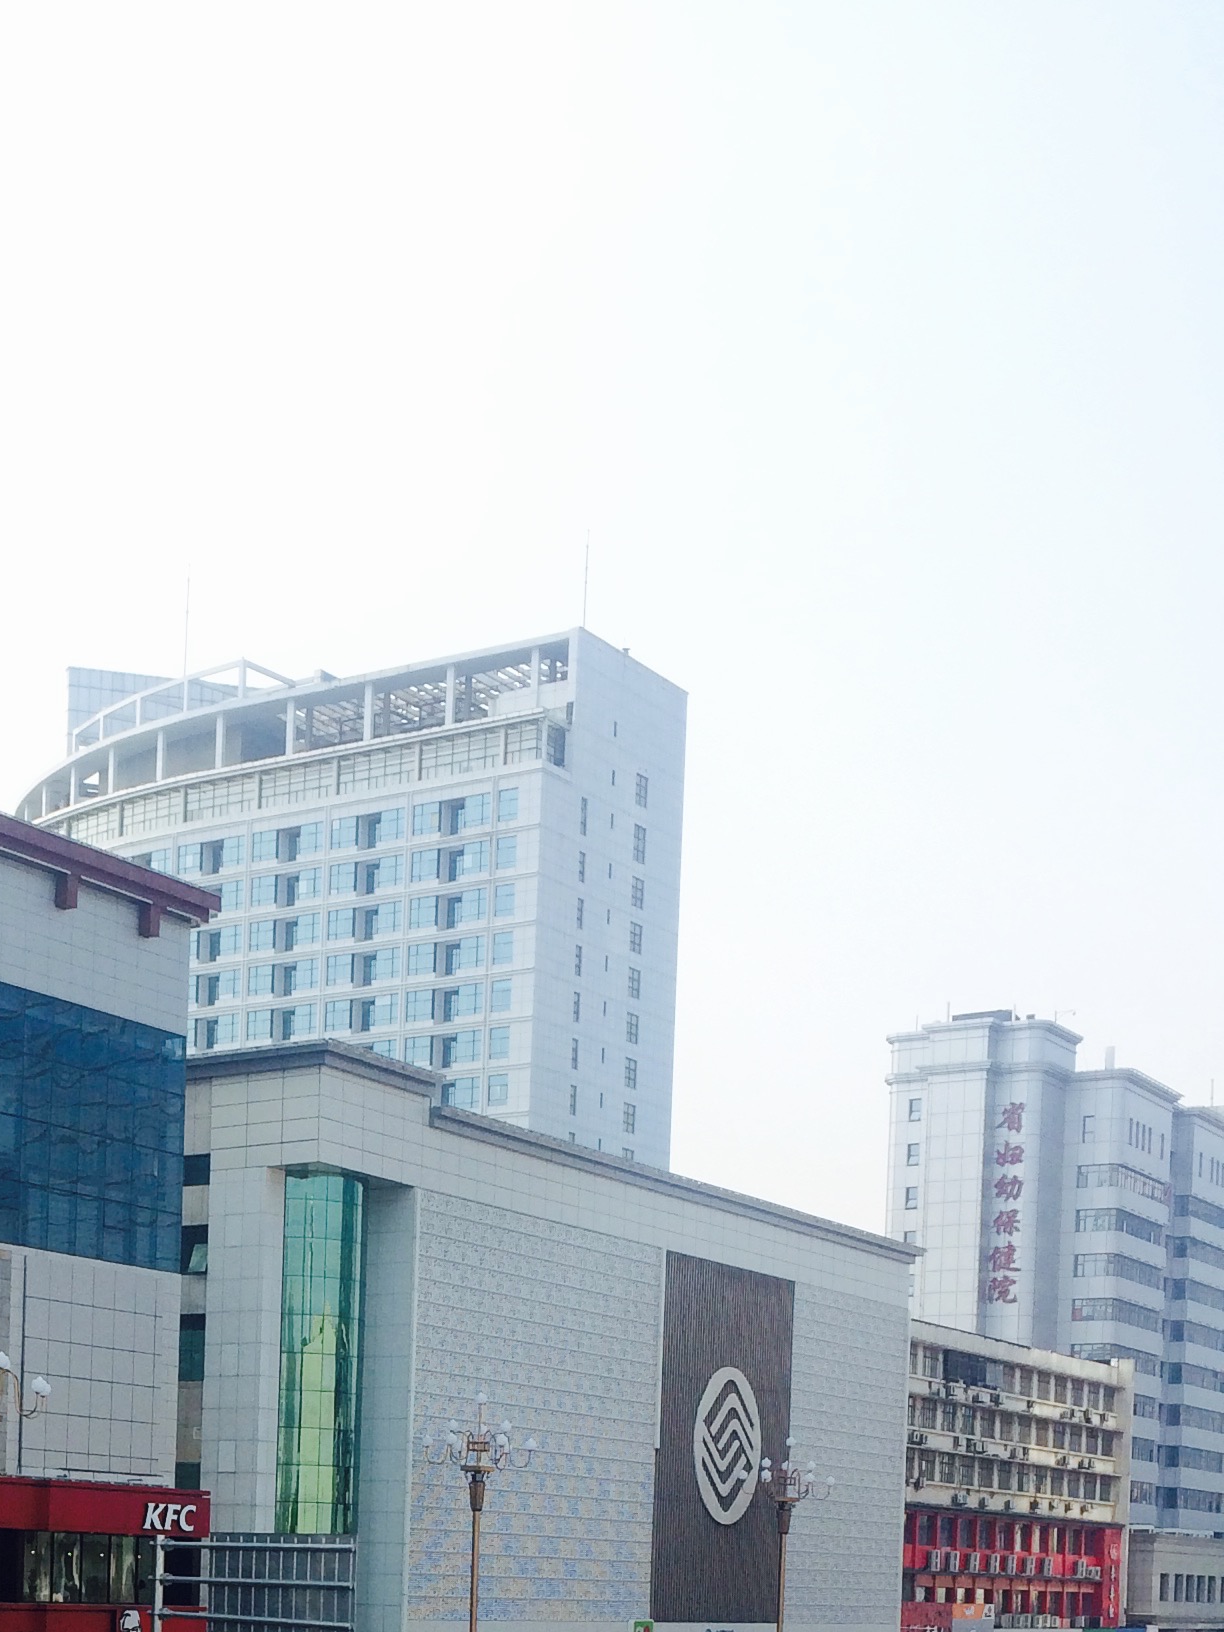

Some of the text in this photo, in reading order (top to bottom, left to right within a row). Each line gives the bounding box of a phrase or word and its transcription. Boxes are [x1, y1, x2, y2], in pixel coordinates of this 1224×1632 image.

[988, 1102, 1025, 1304] 省妇幼保健院
[142, 1502, 196, 1531] KFC
